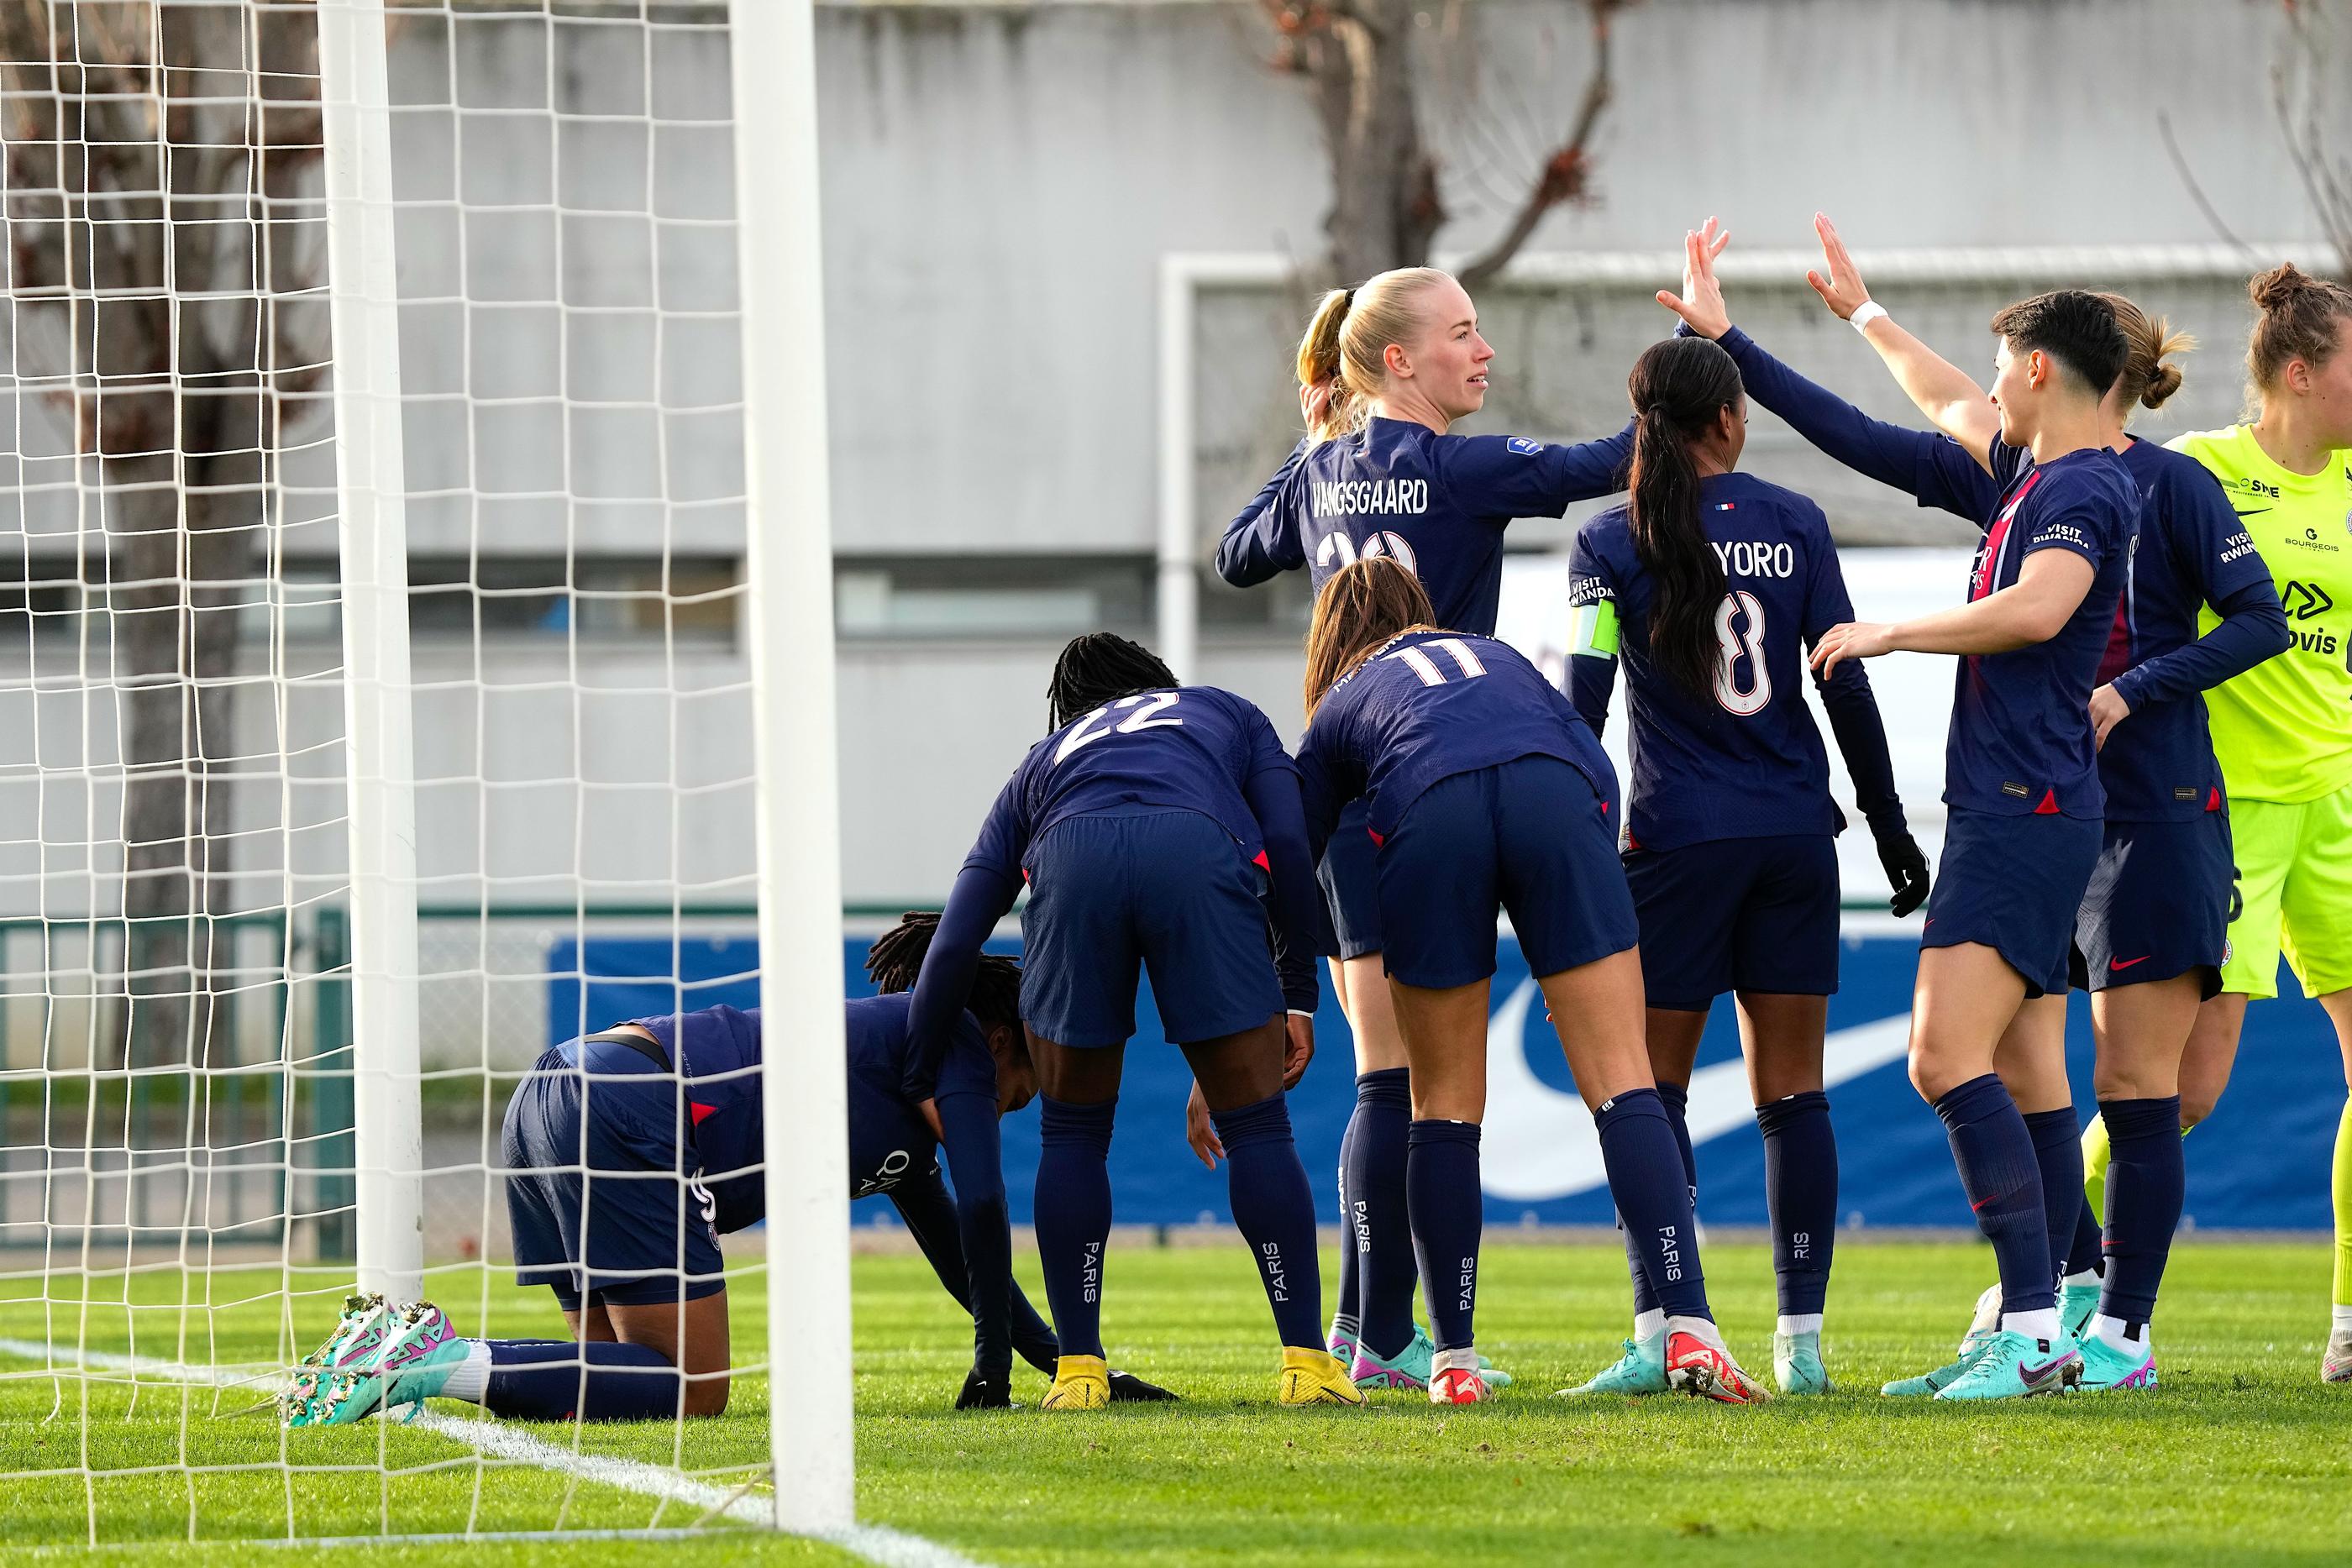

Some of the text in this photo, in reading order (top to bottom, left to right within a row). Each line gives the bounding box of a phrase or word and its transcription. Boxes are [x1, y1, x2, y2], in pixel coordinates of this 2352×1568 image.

[1312, 479, 1428, 517] VANGSGAARD
[2046, 523, 2082, 539] VISIT
[2285, 538, 2339, 553] BOURGEOIS
[1572, 576, 1601, 594] VISIT
[1704, 541, 1794, 578] YORO
[1569, 586, 1616, 606] WANDA
[1378, 637, 1488, 688] 11
[1712, 590, 1772, 716] 8
[1053, 691, 1184, 767] 22
[1354, 1200, 1371, 1254] PARIS
[1083, 1241, 1100, 1304] PARIS
[1262, 1241, 1289, 1303] PARIS
[1658, 1225, 1683, 1282] PARIS
[1459, 1256, 1474, 1312] PARIS
